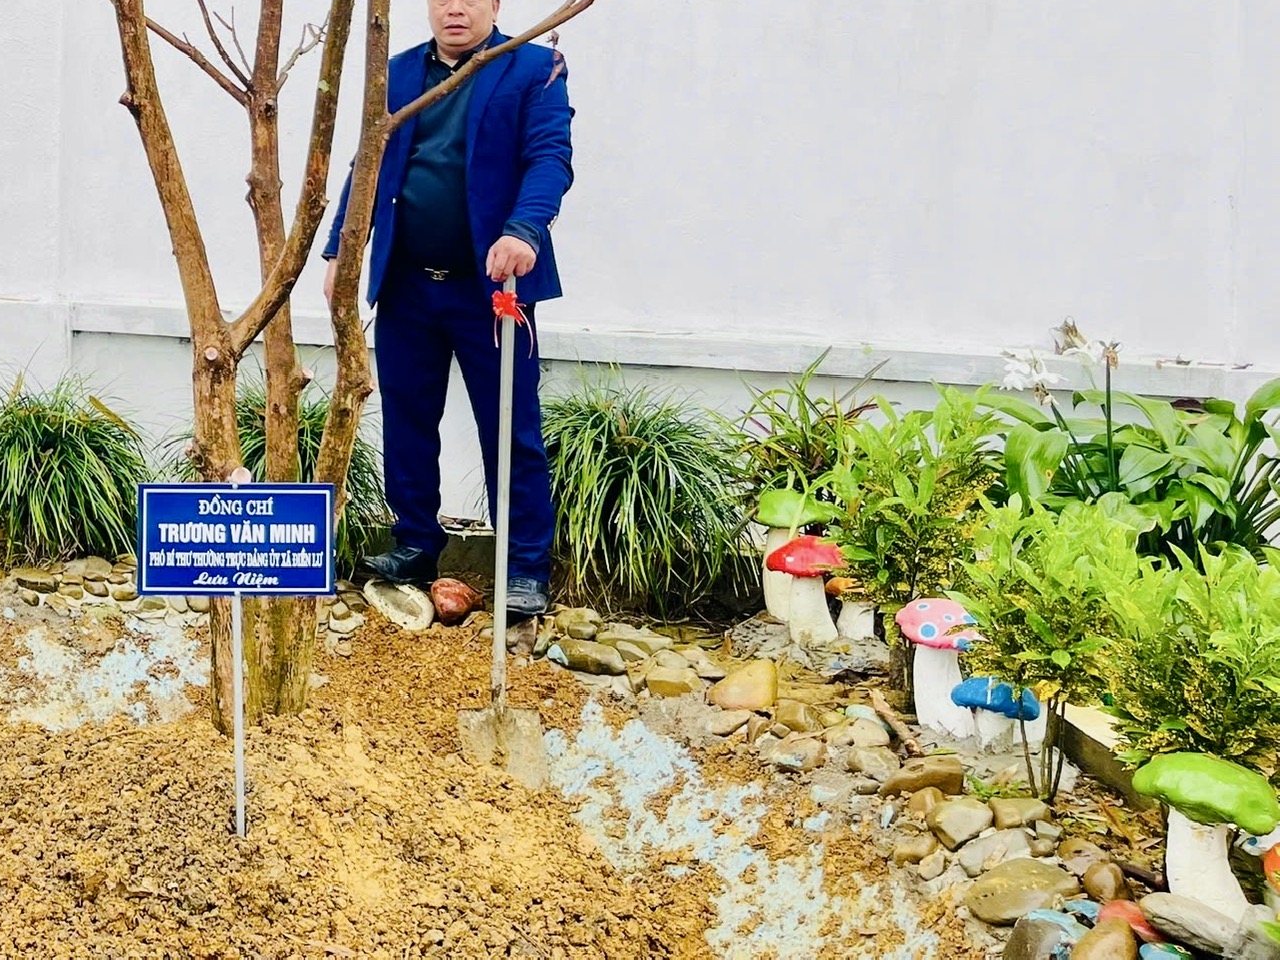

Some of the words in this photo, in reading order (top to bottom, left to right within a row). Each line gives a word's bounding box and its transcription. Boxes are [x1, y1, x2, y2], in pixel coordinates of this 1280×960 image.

[198, 494, 243, 516] ĐỒNG
[246, 496, 274, 516] CHÍ
[158, 521, 227, 544] TRƯƠNG
[230, 519, 265, 544] VĂN
[269, 523, 316, 544] MINH
[149, 548, 166, 567] PHÓ
[166, 548, 175, 567] BÍ
[175, 550, 193, 567] THƯ
[192, 548, 225, 567] THƯỜNG
[225, 550, 247, 571] TRỰC
[246, 547, 269, 567] ĐẢNG
[280, 549, 292, 567] XÃ
[311, 550, 324, 567] LƯ
[192, 571, 229, 585] Lưu
[232, 571, 279, 589] Niệm
